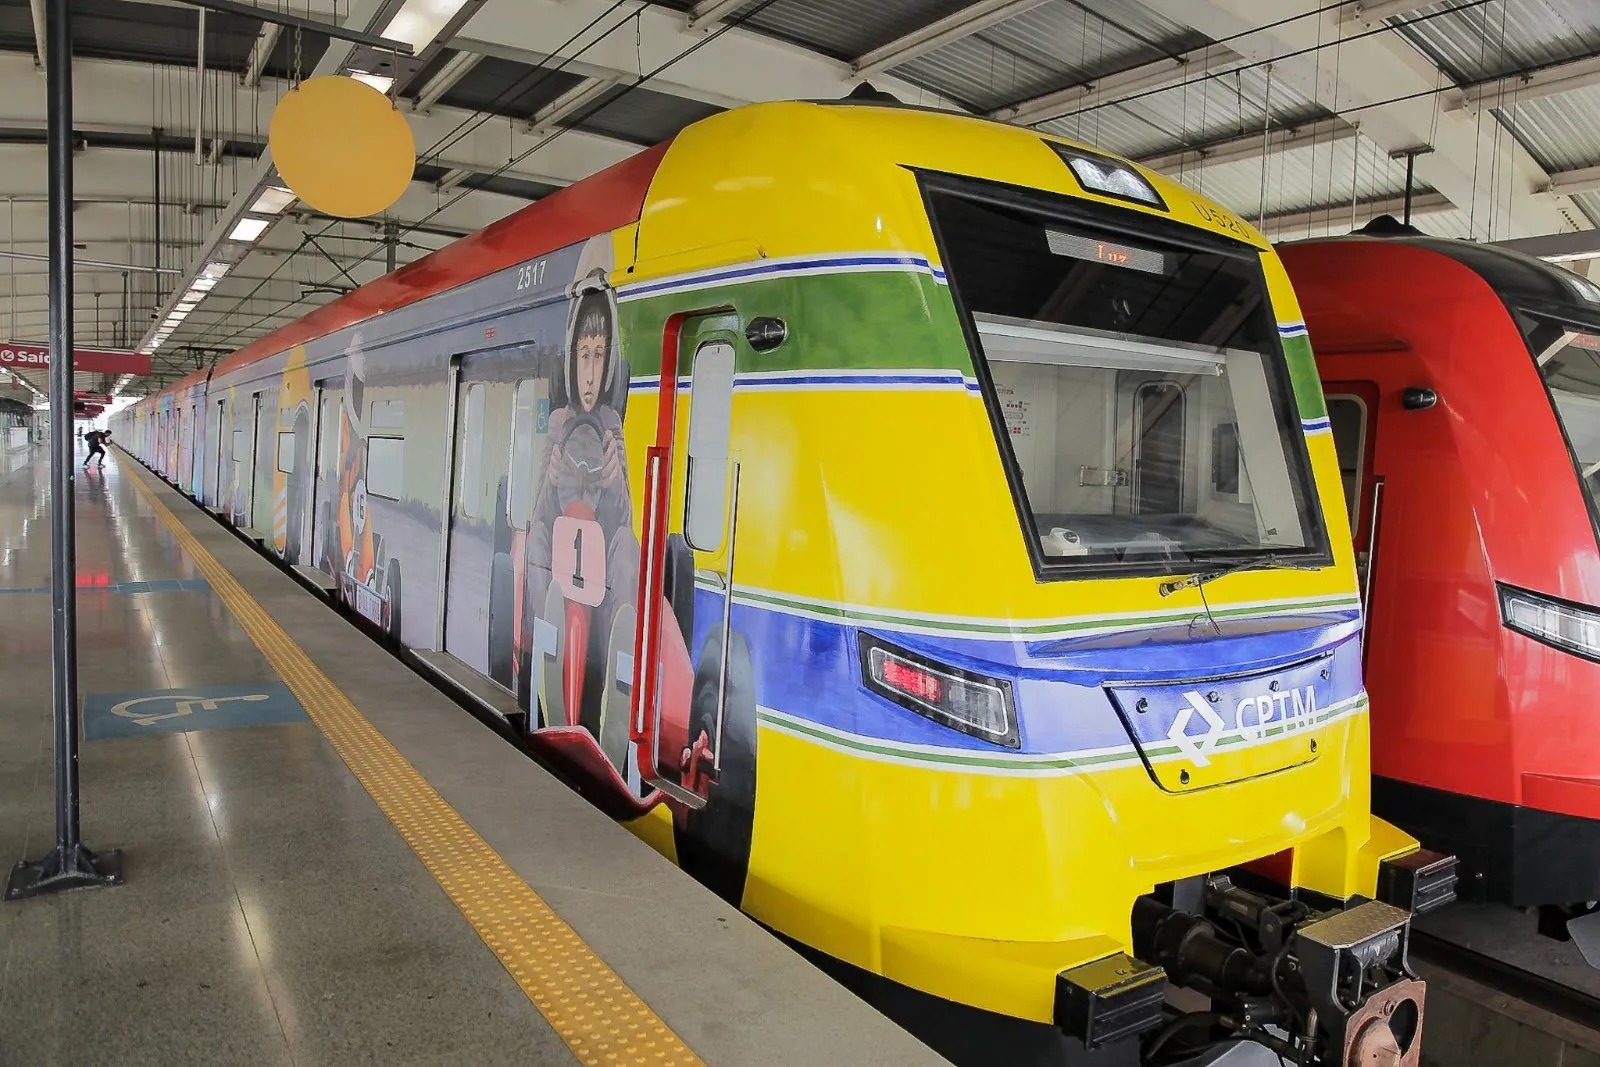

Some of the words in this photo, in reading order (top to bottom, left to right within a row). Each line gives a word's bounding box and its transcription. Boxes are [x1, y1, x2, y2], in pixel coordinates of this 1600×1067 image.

[517, 260, 548, 291] 2517
[572, 528, 585, 589] 1
[1236, 685, 1317, 742] CPTM
